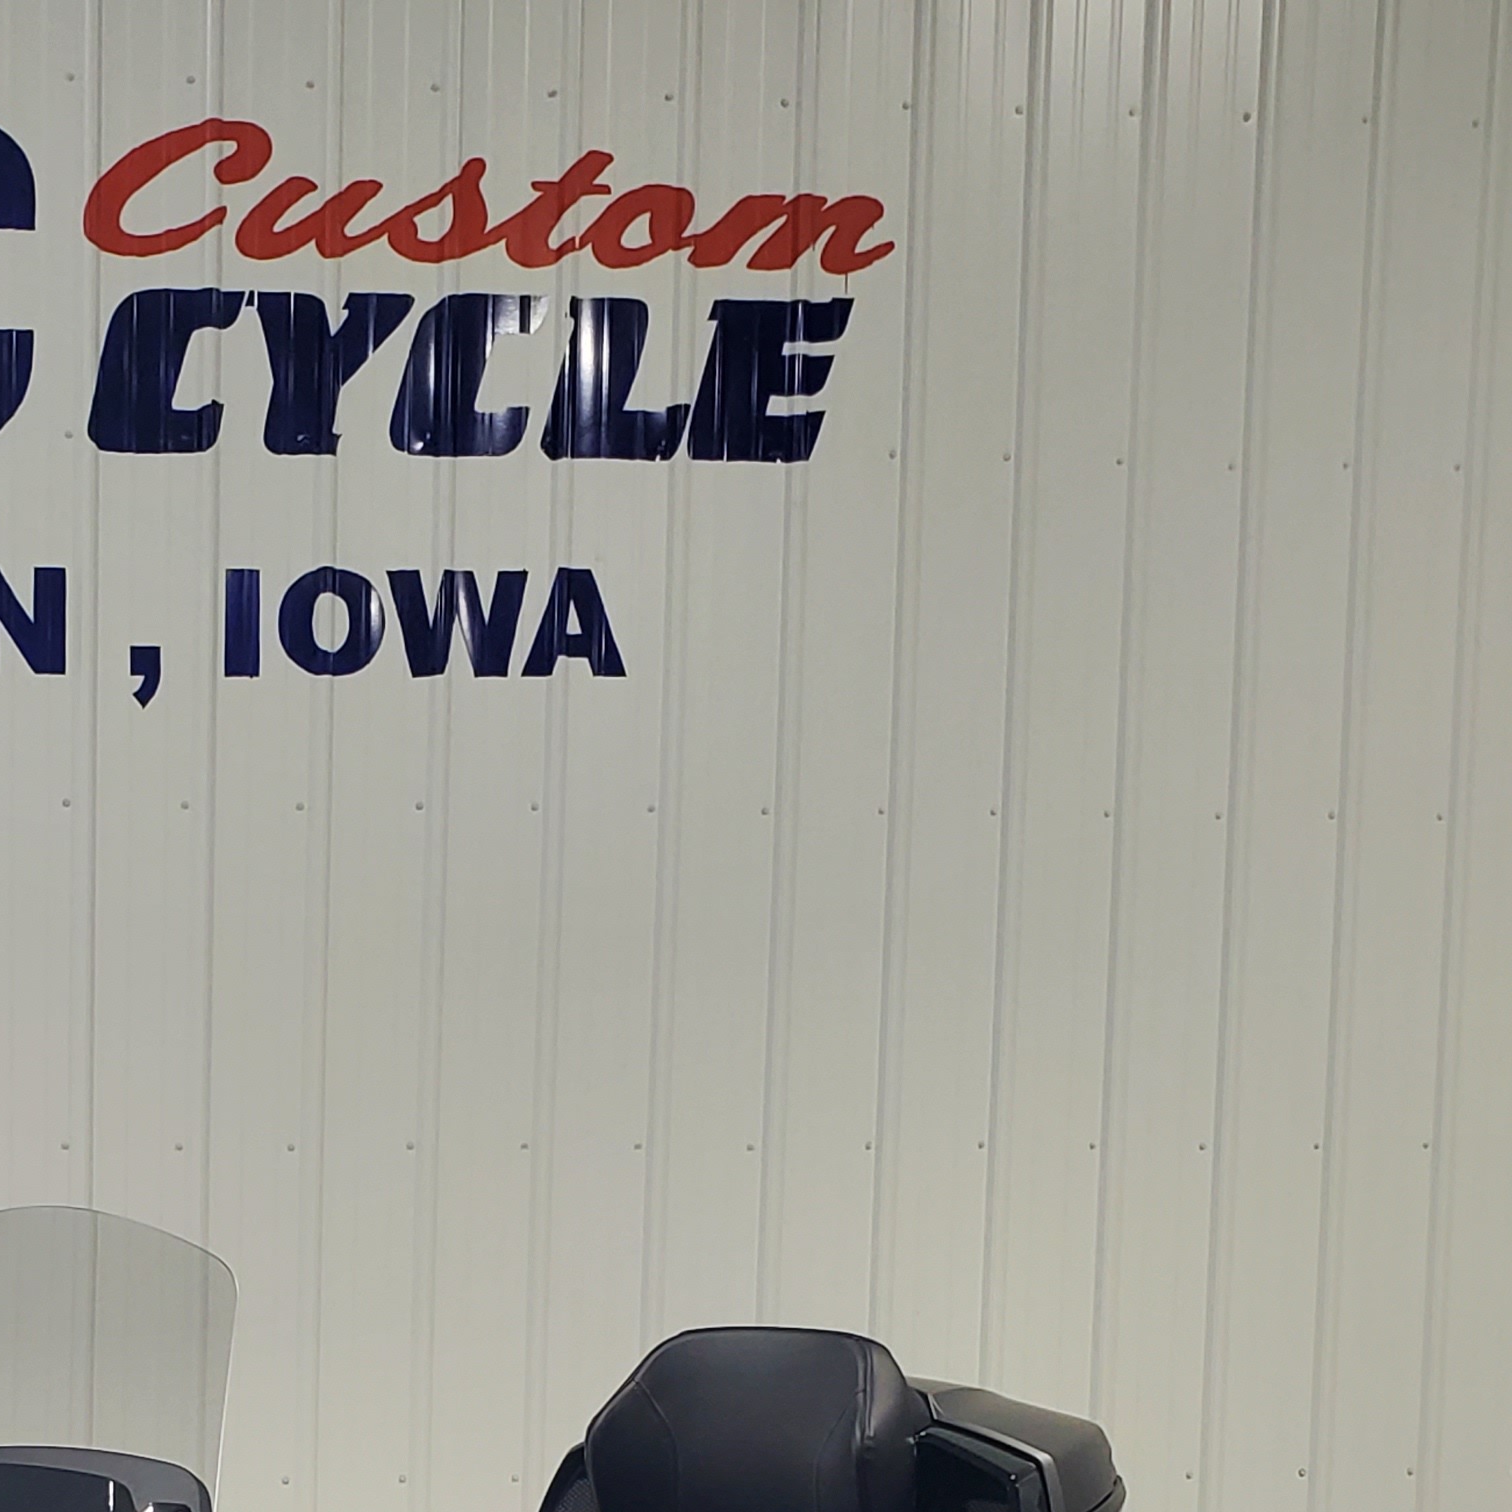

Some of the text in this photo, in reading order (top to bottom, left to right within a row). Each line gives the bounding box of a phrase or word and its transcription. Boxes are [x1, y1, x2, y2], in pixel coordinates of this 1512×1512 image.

[84, 119, 894, 275] Custom
[86, 286, 856, 464] CYCLE
[223, 566, 628, 679] IOWA
